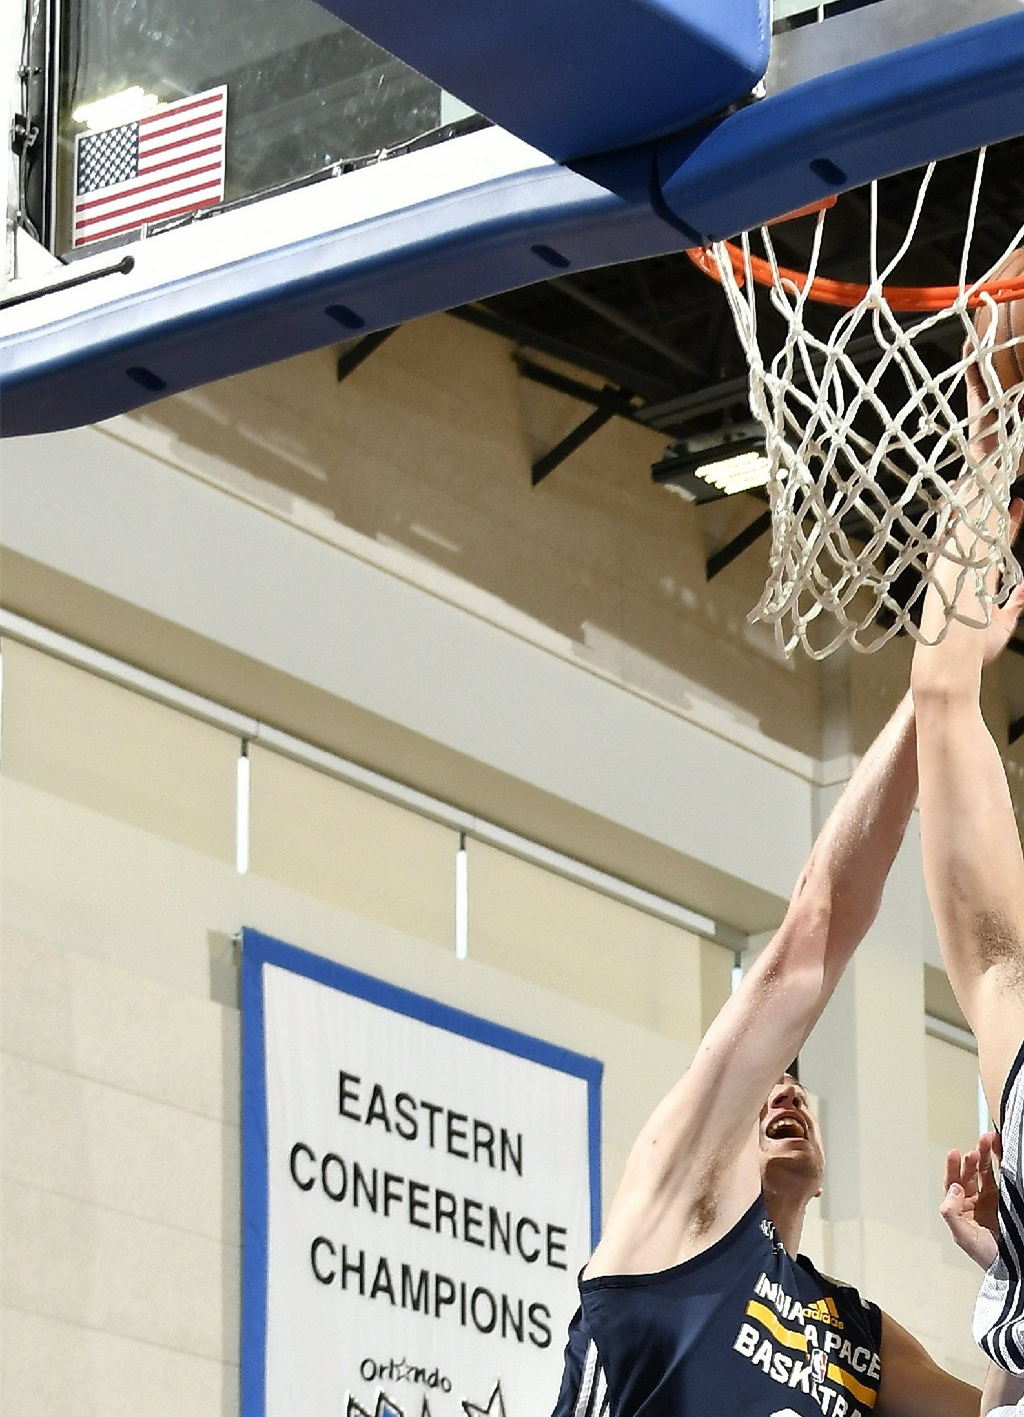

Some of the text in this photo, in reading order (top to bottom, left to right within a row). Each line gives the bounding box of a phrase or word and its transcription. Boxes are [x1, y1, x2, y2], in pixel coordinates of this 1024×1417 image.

[339, 1069, 523, 1178] EASTERN
[289, 1141, 567, 1271] CONFERENCE
[310, 1235, 552, 1349] CHAMPIONS
[803, 1307, 845, 1330] adidas
